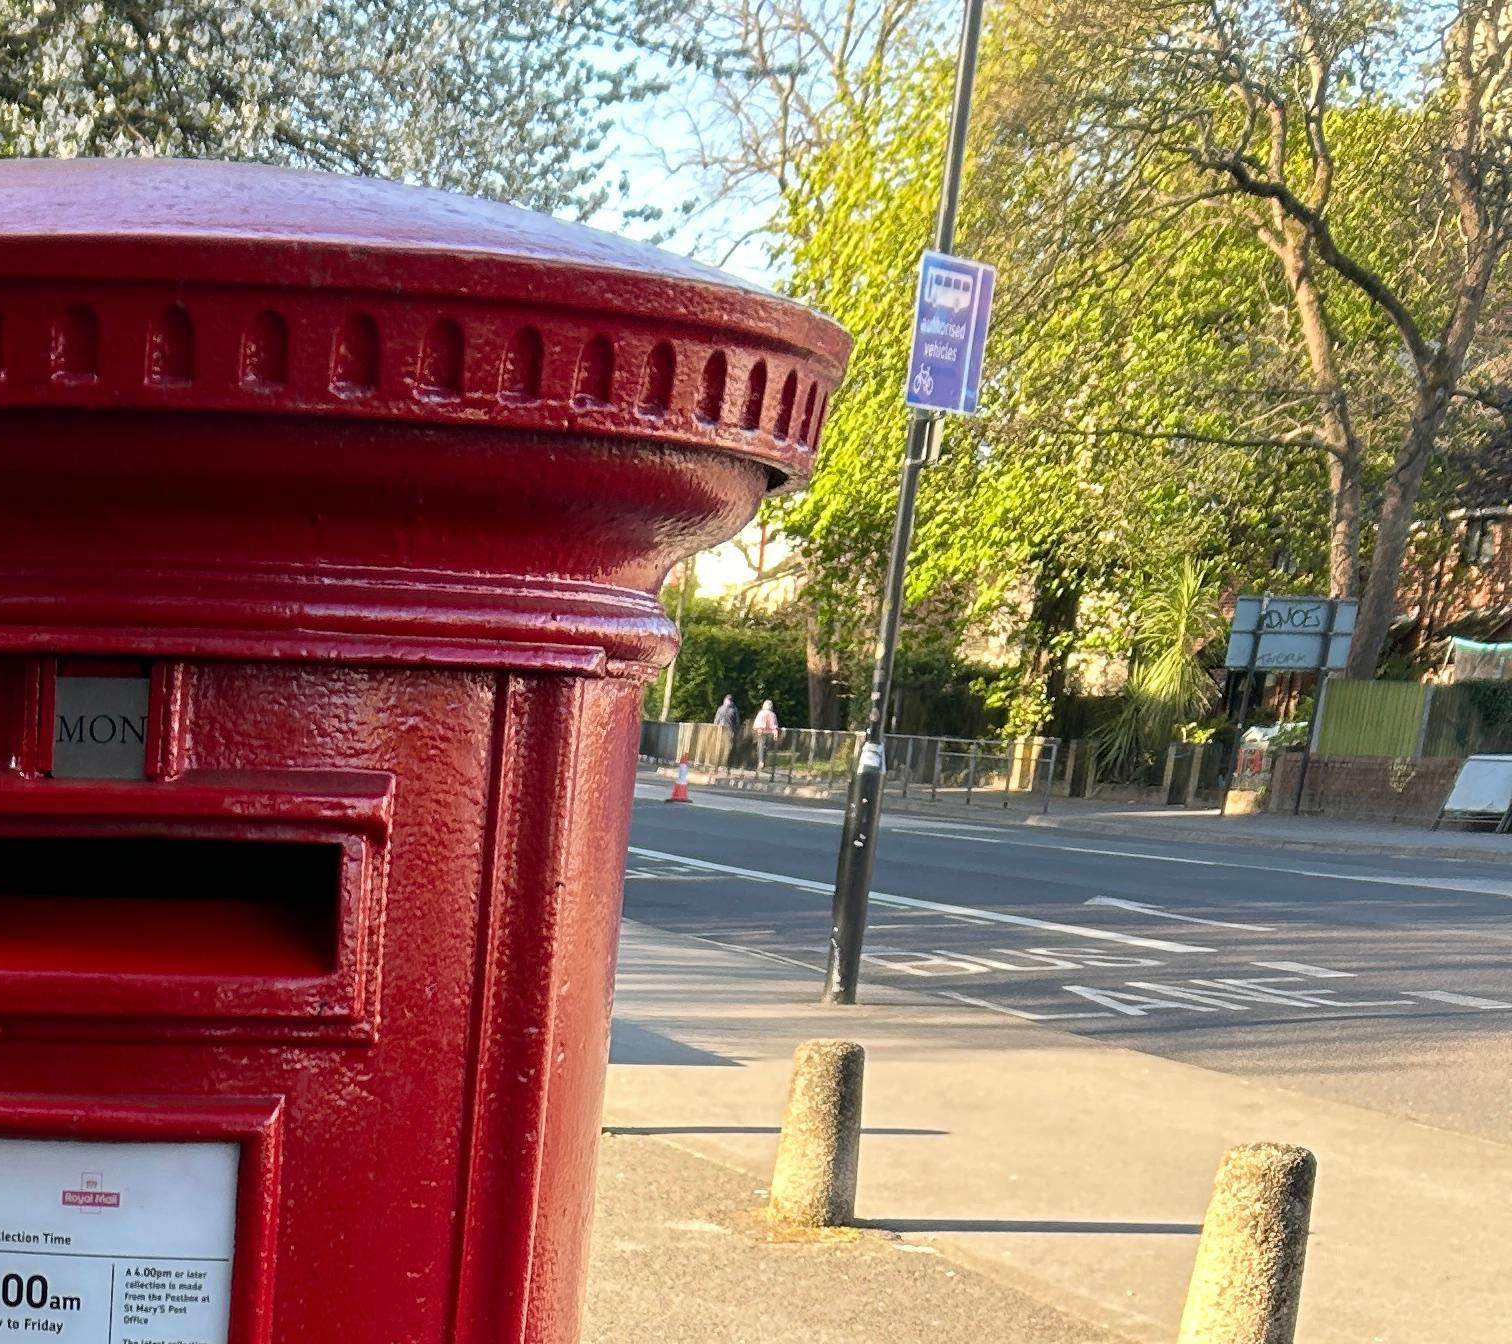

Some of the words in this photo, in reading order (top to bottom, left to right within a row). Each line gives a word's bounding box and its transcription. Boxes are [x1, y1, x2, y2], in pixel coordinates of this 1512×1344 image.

[924, 340, 957, 361] vehicles
[56, 714, 149, 744] MON
[938, 976, 1418, 1021] LANE
[64, 1191, 93, 1205] Royal
[95, 1192, 118, 1205] Mail
[43, 1232, 72, 1246] Time
[125, 1268, 132, 1278] A
[134, 1266, 172, 1280] 4.00pm
[175, 1271, 185, 1279] or
[187, 1270, 207, 1280] later
[125, 1280, 166, 1290] collection
[169, 1281, 176, 1290] is
[179, 1282, 203, 1291] made
[125, 1292, 146, 1301] from
[148, 1293, 162, 1302] the
[201, 1295, 210, 1303] at
[123, 1304, 133, 1313] St
[168, 1305, 188, 1314] Post
[8, 1319, 20, 1330] to
[24, 1318, 64, 1335] Friday
[123, 1315, 149, 1325] Office
